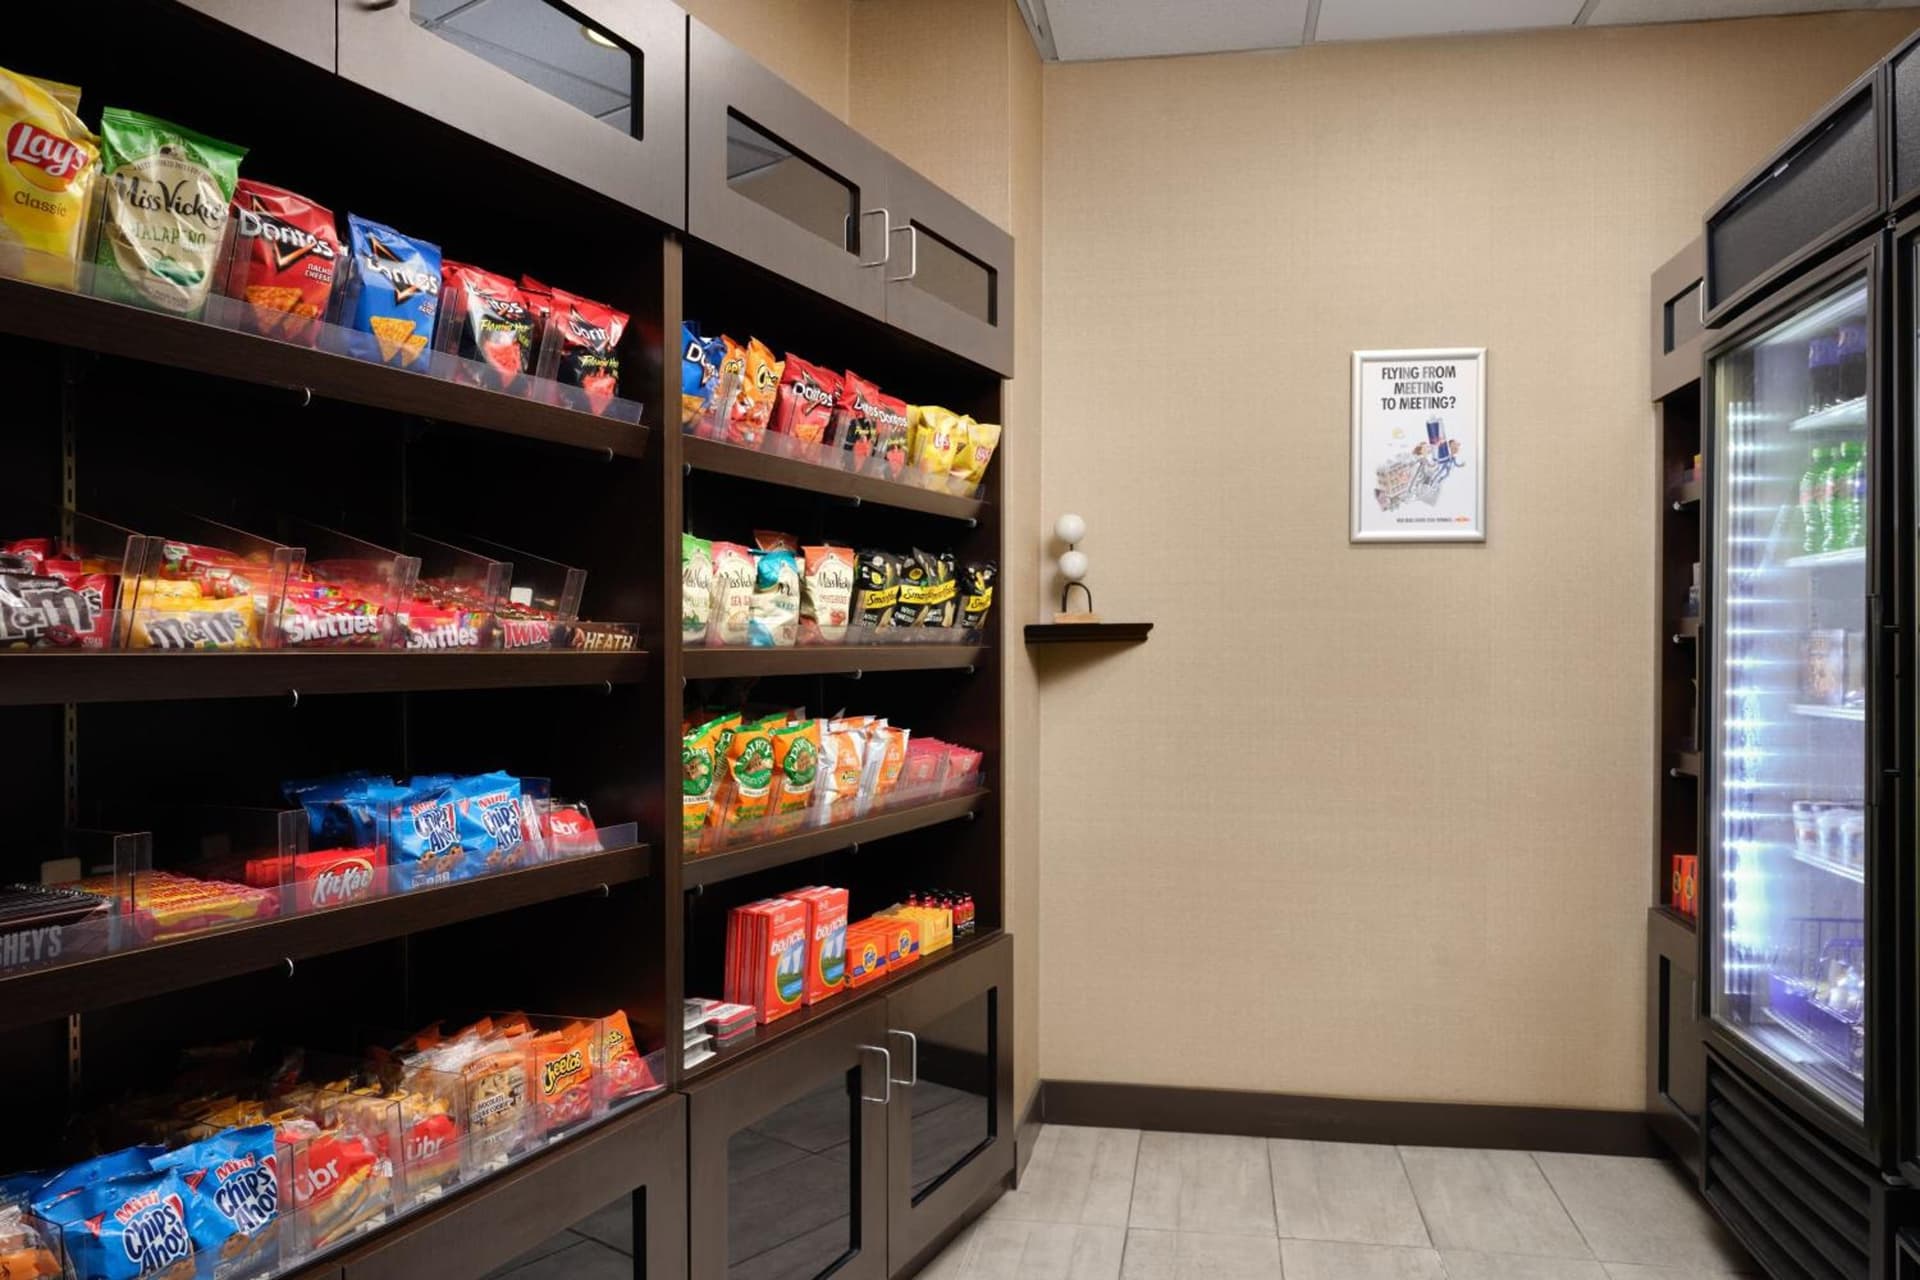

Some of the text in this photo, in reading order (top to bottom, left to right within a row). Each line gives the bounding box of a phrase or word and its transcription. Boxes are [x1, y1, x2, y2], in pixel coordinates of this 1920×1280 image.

[14, 190, 67, 216] Classic
[238, 209, 334, 257] Doritos
[1382, 365, 1456, 380] FLYING FROM
[1394, 381, 1444, 395] MEETING
[1382, 396, 1456, 410] TO MEETING?
[282, 611, 378, 644] Skittles
[584, 632, 634, 650] HEATH
[482, 803, 517, 837] Chips
[0, 925, 62, 967] HEY'S
[543, 1050, 582, 1096] Cheetos
[215, 1167, 271, 1217] Chips
[125, 1205, 176, 1260] Chips
